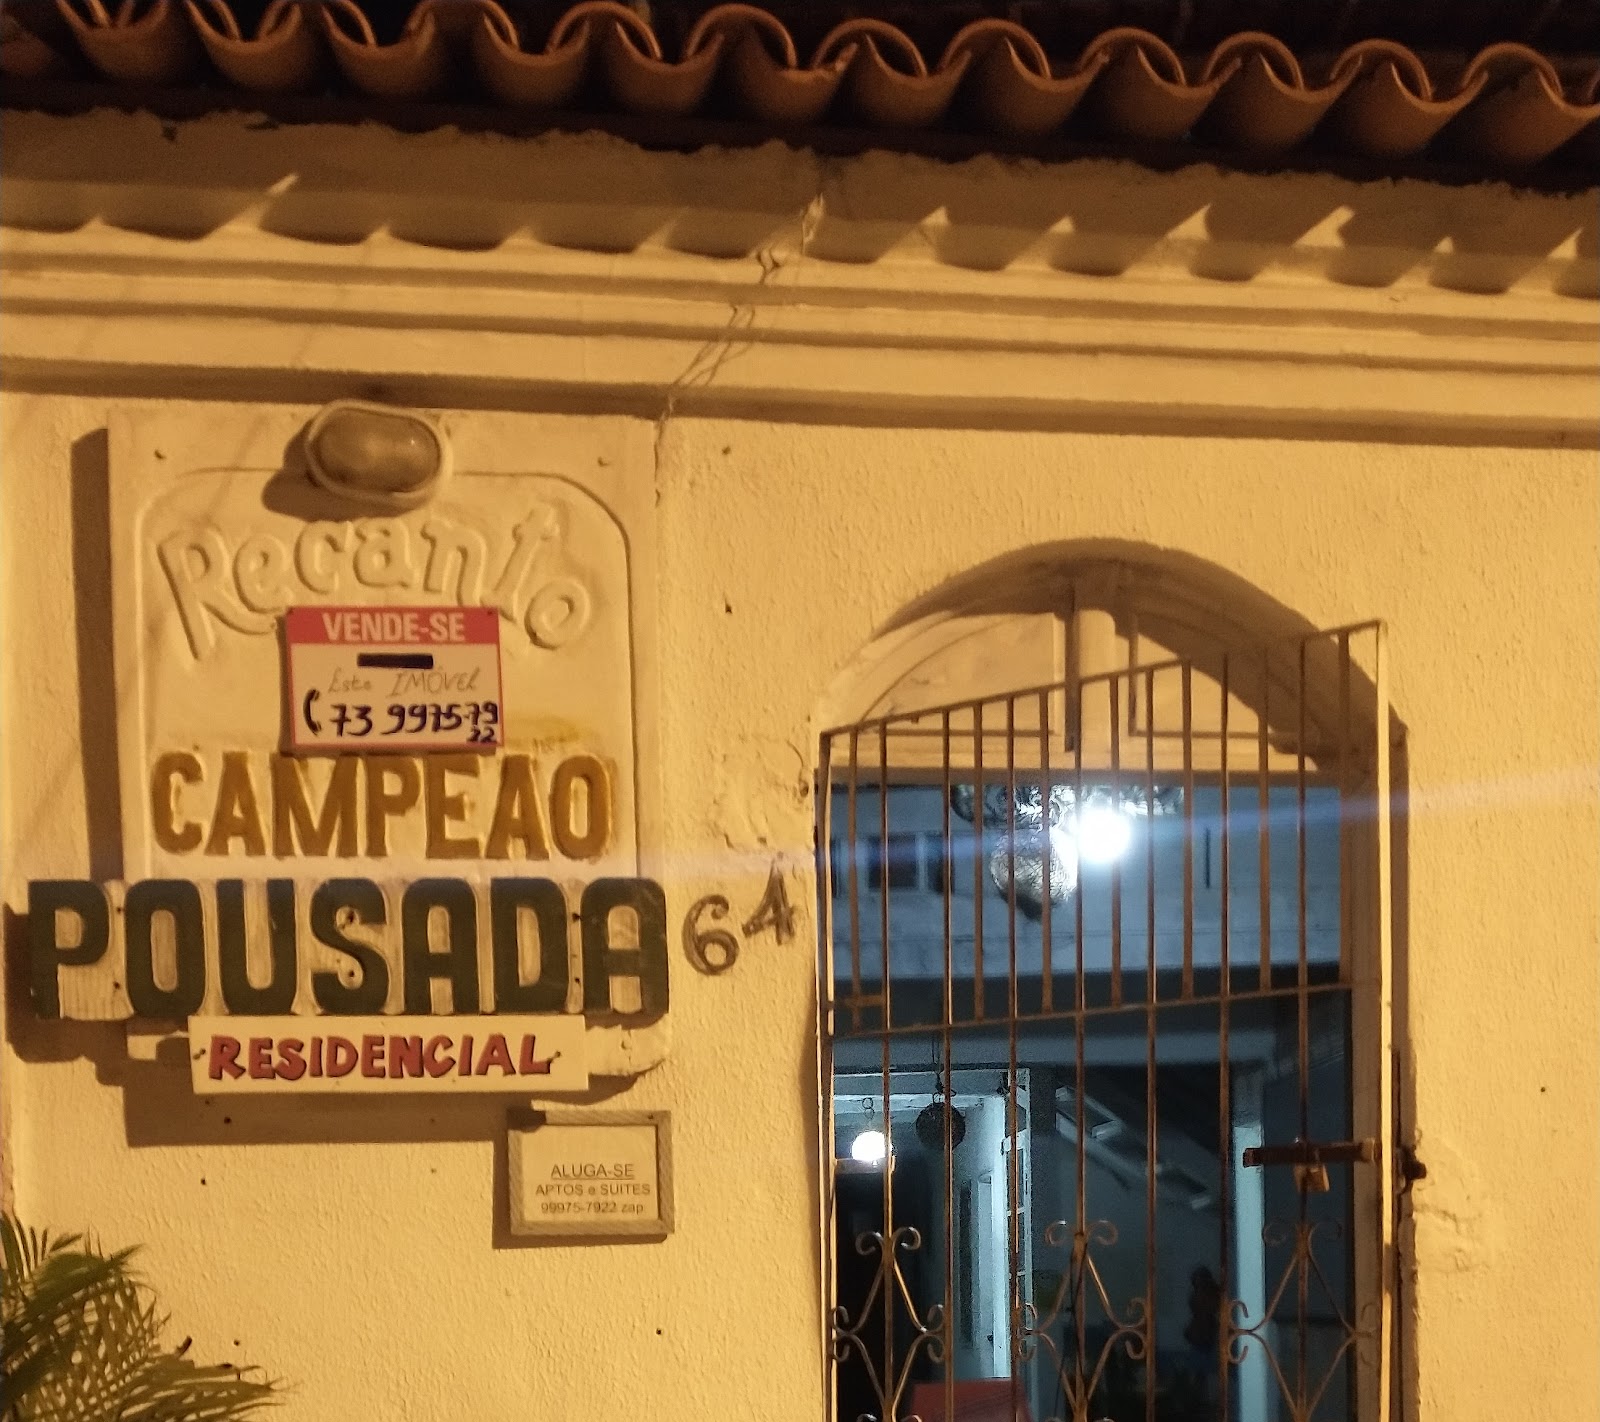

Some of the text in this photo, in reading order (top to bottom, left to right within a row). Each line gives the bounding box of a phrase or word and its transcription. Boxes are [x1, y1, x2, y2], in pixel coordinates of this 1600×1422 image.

[157, 504, 593, 660] Recanto
[321, 612, 466, 642] VENDE-SE
[329, 703, 373, 737] 73
[682, 856, 796, 976] 64
[28, 876, 670, 1019] POUSADA
[208, 1033, 553, 1081] RESIDENCIAL
[551, 1163, 635, 1180] ALUGA-SE
[535, 1183, 584, 1197] APTOS
[588, 1186, 596, 1196] e
[541, 1201, 644, 1215] 99975-7922 zap
